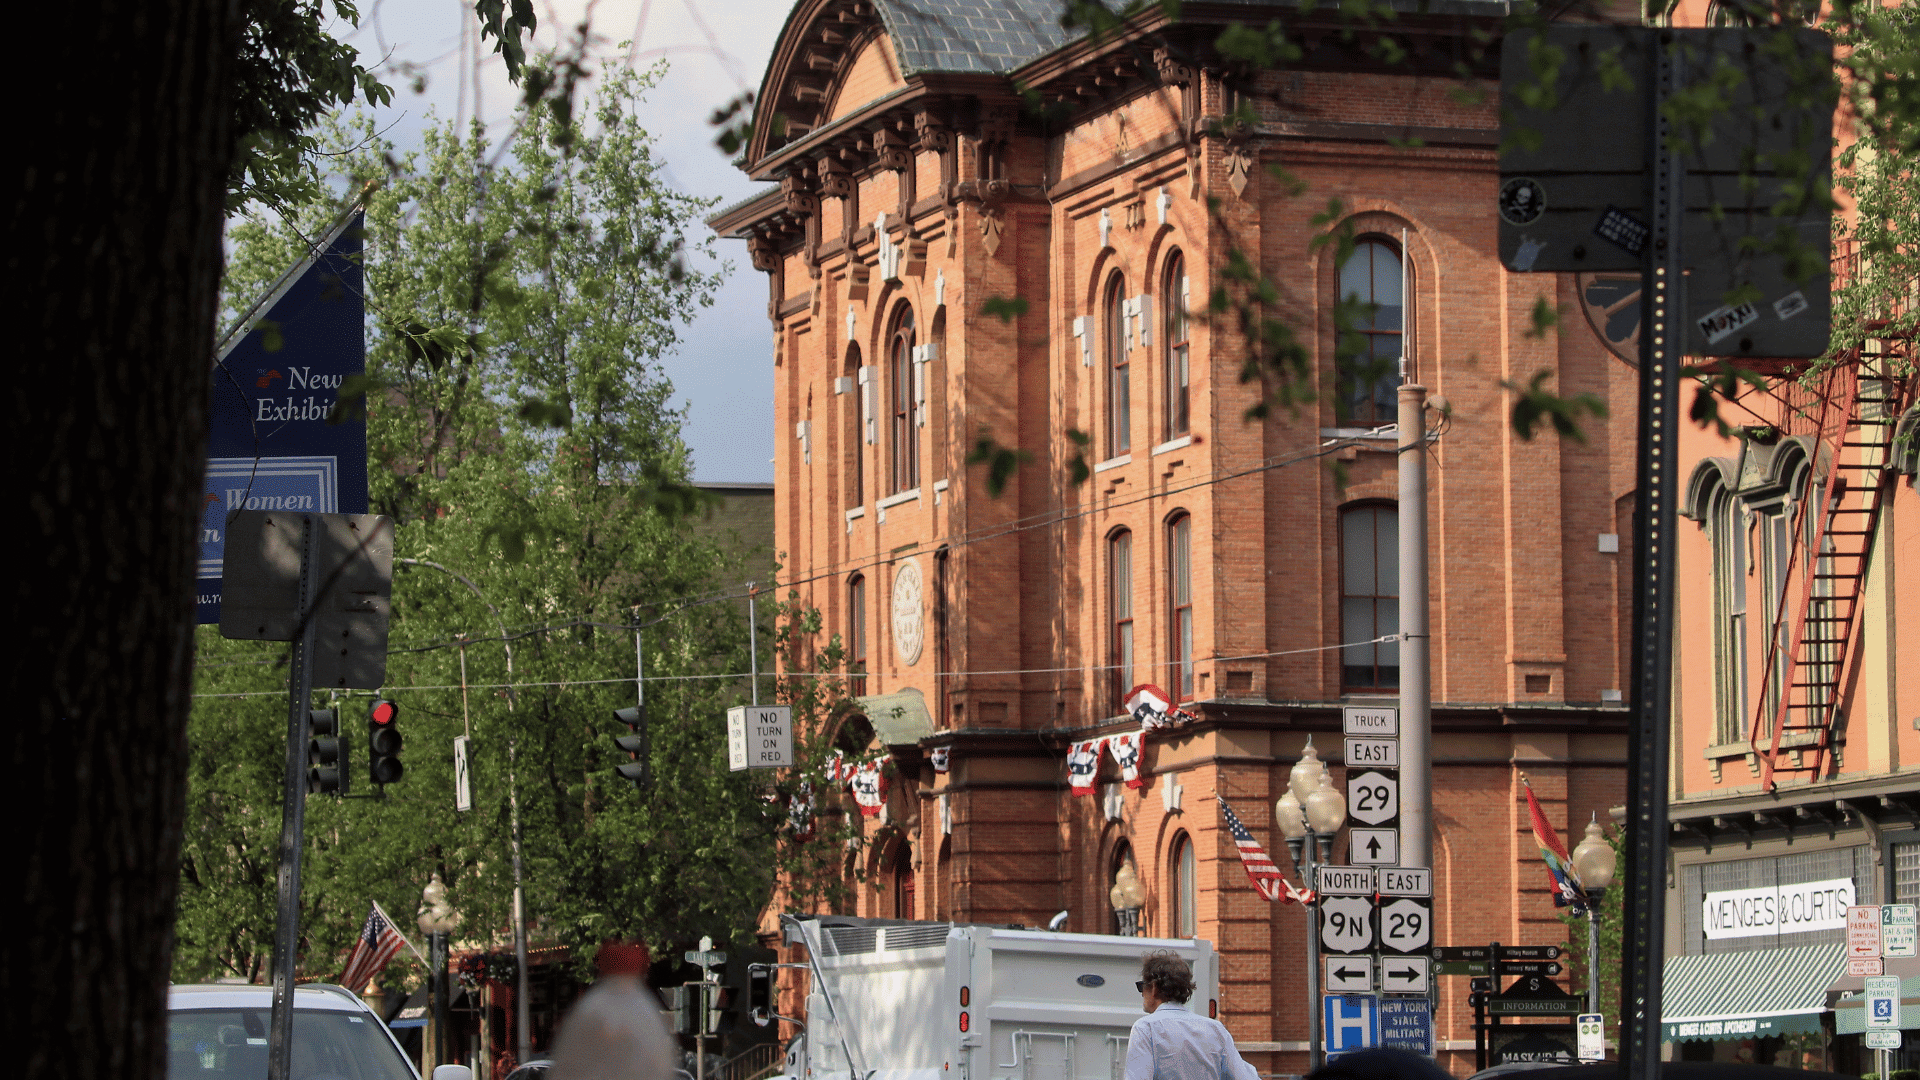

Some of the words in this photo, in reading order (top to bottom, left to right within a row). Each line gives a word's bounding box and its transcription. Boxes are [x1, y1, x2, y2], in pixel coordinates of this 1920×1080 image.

[288, 366, 343, 390] New
[225, 487, 314, 511] Women
[760, 712, 777, 724] NO
[1354, 715, 1387, 727] TRUCK
[756, 727, 782, 737] TURN
[762, 739, 777, 749] ON
[760, 751, 781, 762] RED
[1354, 743, 1389, 761] EAST
[1356, 785, 1390, 812] 29
[1324, 872, 1369, 889] NORTH
[1386, 872, 1422, 891] EAST
[1780, 894, 1789, 924] &
[1791, 887, 1848, 923] CURTIS
[1857, 910, 1869, 920] NO
[1883, 909, 1890, 923] 2
[1899, 907, 1908, 915] HR
[1329, 911, 1363, 938] 9N
[1389, 912, 1422, 939] 29
[1849, 922, 1878, 930] PARKING
[1506, 949, 1522, 957] Military
[1522, 949, 1539, 957] Museum
[1468, 964, 1484, 972] Parking
[1529, 978, 1540, 991] S
[1867, 981, 1897, 989] RESERVED
[1868, 990, 1895, 998] PARKING
[1381, 1002, 1402, 1013] NEW
[1403, 1002, 1428, 1013] YORK
[1502, 1002, 1567, 1011] INFORMATION
[1332, 998, 1371, 1050] H
[1392, 1015, 1419, 1026] STATE
[1385, 1028, 1425, 1039] MILITARY
[1502, 1052, 1535, 1062] MASK
